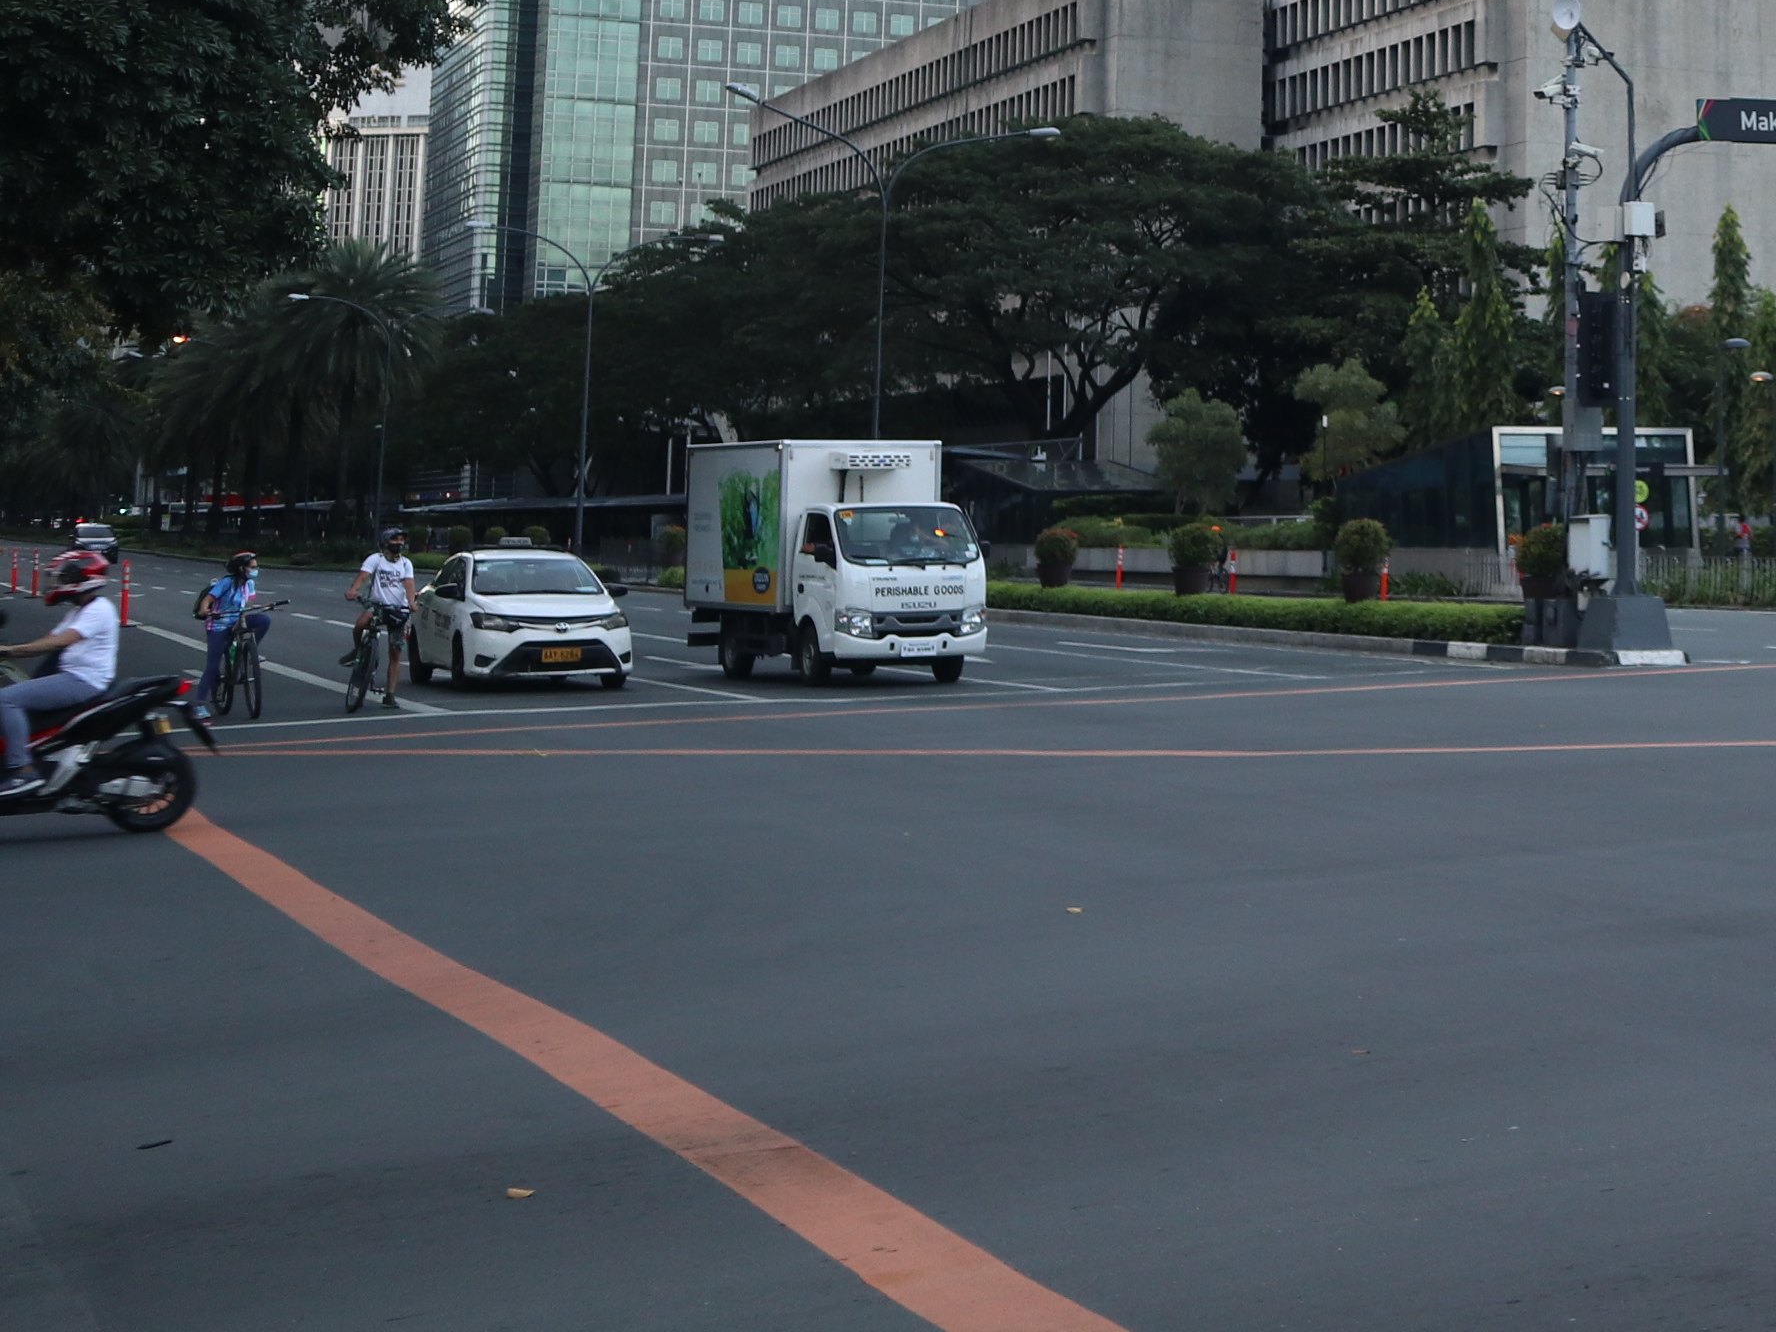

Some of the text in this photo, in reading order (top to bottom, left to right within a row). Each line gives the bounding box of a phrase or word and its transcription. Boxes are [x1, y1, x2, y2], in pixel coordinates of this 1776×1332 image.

[875, 584, 964, 597] PERISHABLE GOODS
[901, 601, 937, 609] ISUZU
